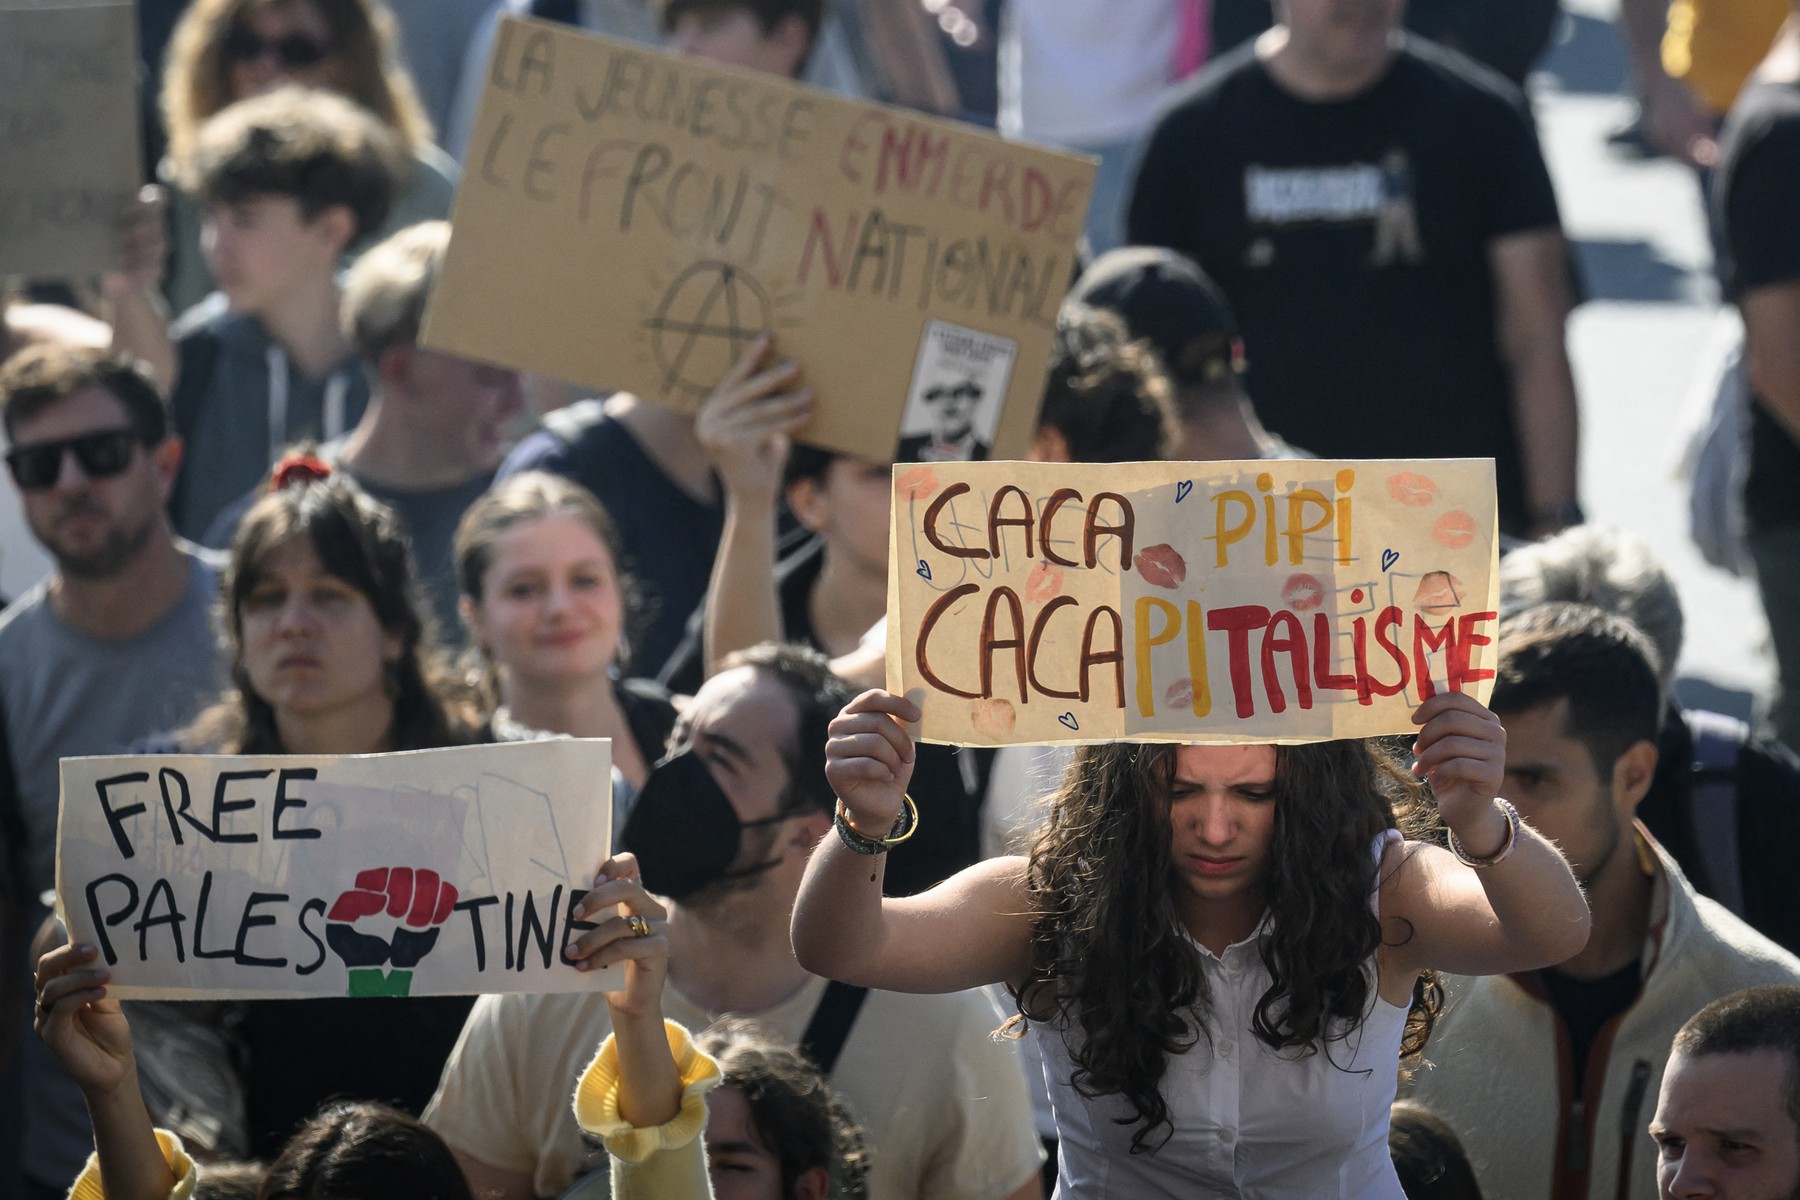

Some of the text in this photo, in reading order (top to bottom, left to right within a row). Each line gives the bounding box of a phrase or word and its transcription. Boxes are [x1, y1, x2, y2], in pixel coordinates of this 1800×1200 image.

[491, 27, 1089, 245] LA JEUNESSE ENMERDE
[481, 113, 1058, 328] LE FRONT NATIONAL
[924, 481, 1136, 571] CACA
[95, 766, 322, 860] FREE
